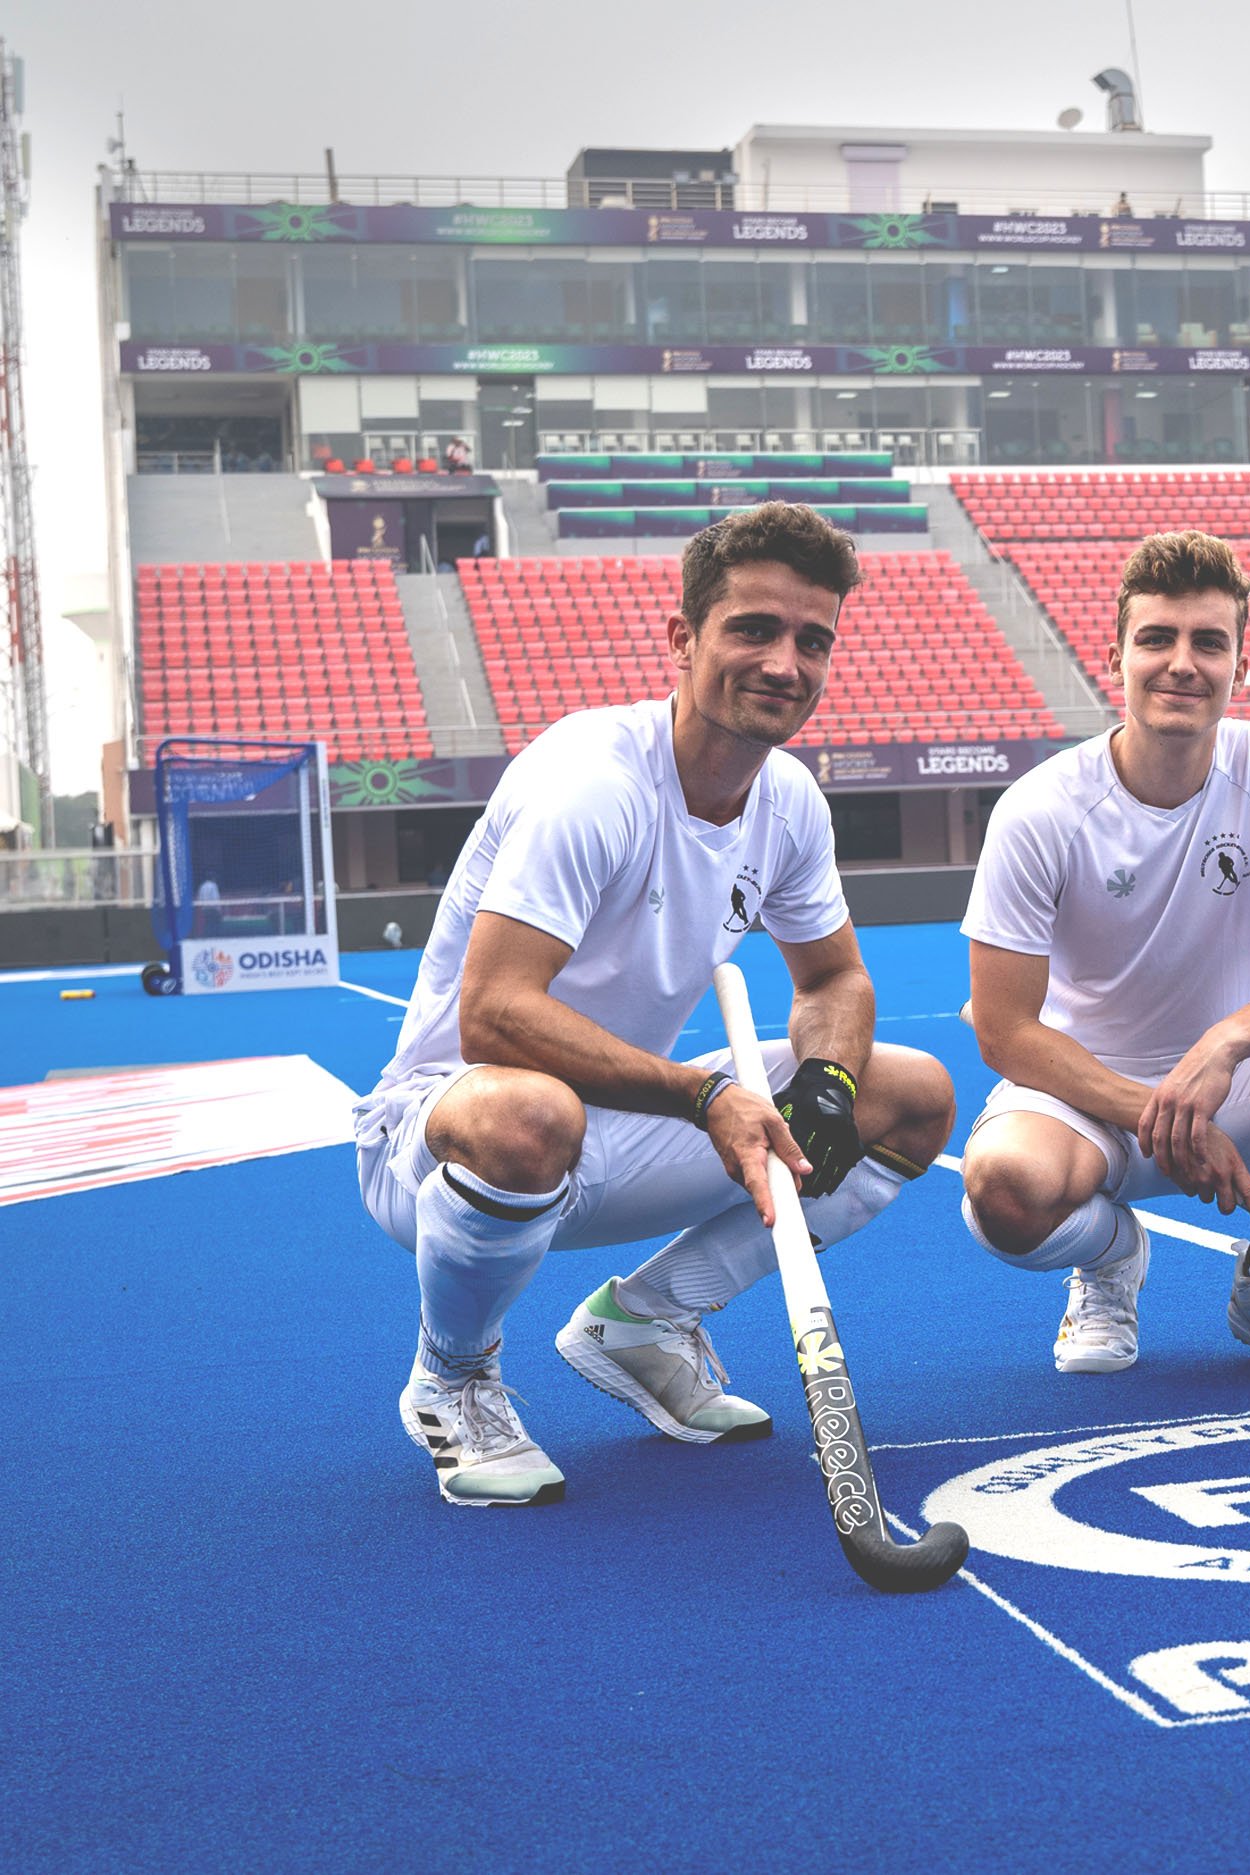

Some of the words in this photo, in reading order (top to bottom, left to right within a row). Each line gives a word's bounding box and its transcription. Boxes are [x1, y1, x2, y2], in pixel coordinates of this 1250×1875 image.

[122, 216, 206, 233] LEGENDS
[733, 225, 808, 240] LEGENDS
[993, 221, 1068, 235] #HWC2023
[1176, 232, 1246, 248] LEGENDS
[137, 355, 212, 371] LEGENDS
[467, 349, 540, 362] #HWC2023
[745, 356, 813, 370] LEGENDS
[1005, 349, 1072, 362] #HWC2023
[1188, 357, 1250, 370] LEGENDS
[916, 753, 1010, 775] LEGENDS
[238, 949, 327, 970] ODISHA
[583, 1326, 605, 1345] adidas
[805, 1375, 875, 1536] Reece
[973, 1435, 1178, 1495] QUALITY
